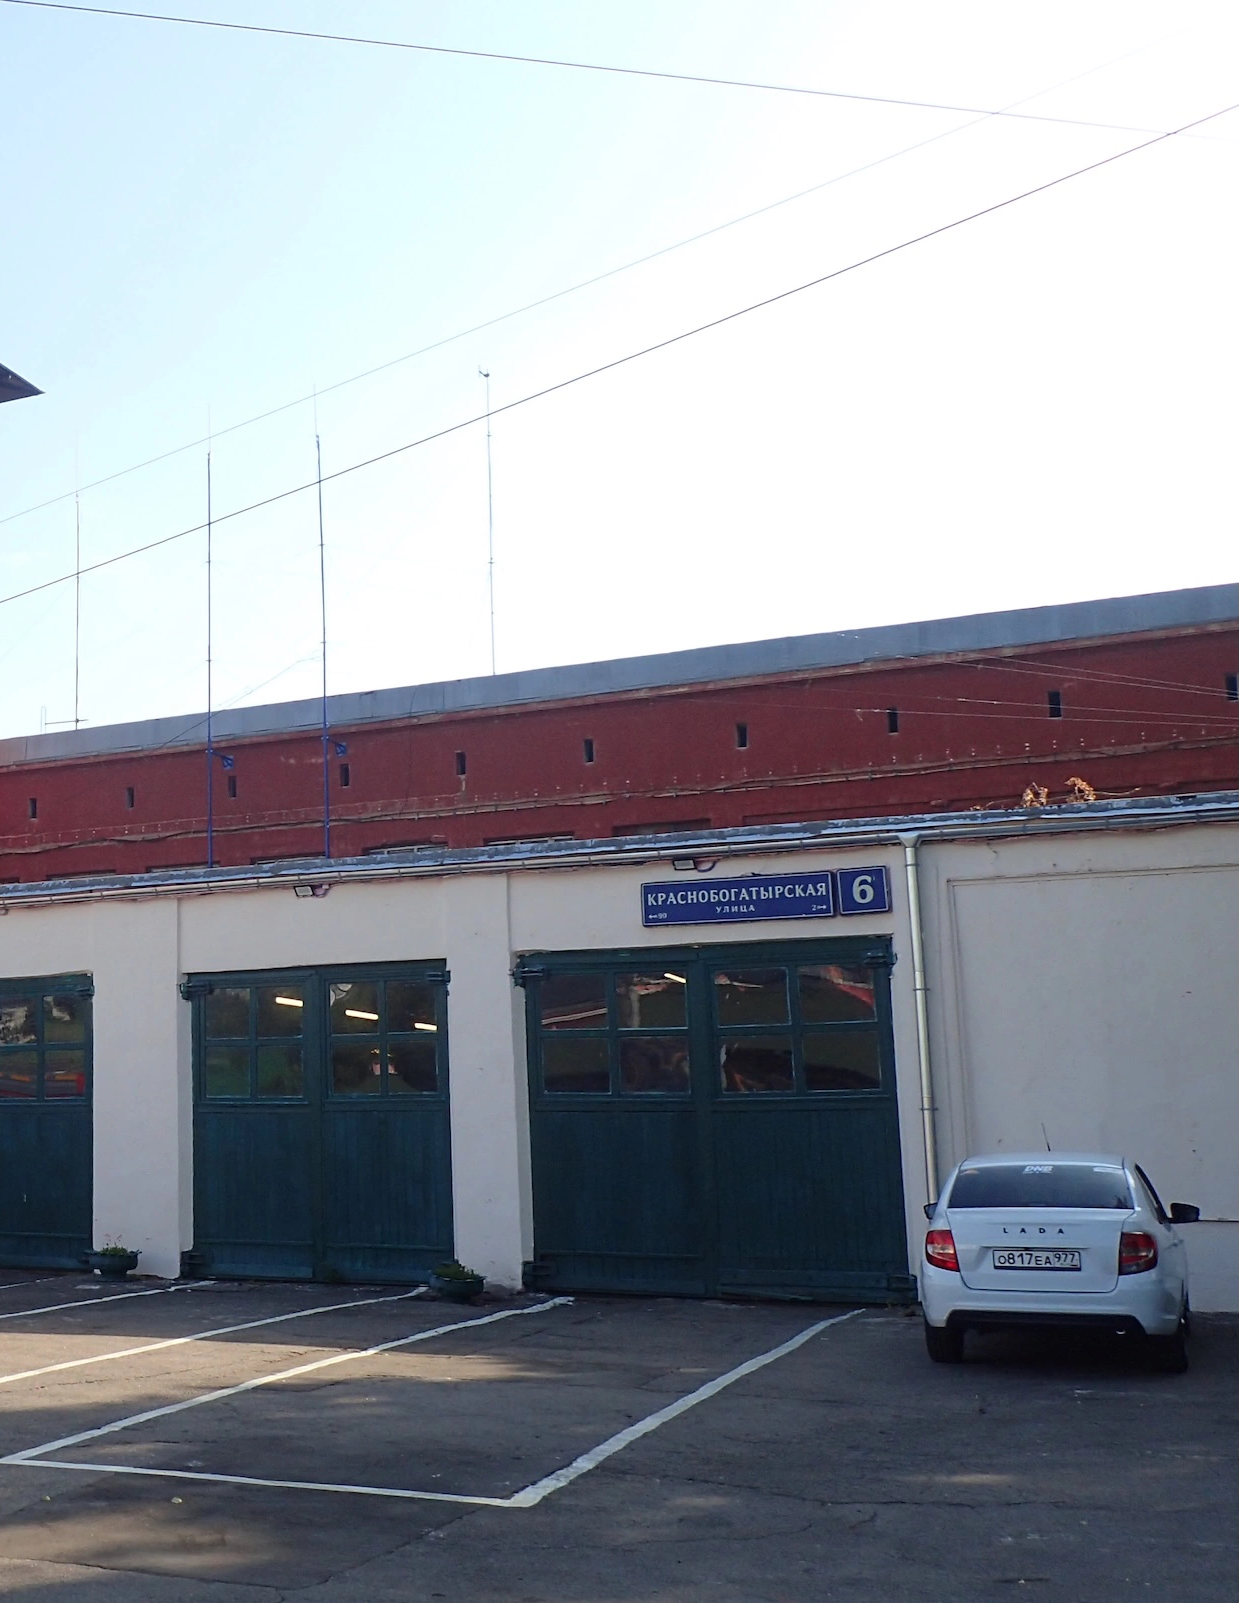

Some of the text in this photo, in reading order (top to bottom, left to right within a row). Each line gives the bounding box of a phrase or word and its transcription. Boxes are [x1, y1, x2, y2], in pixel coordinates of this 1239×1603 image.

[647, 882, 827, 906] КРАСНОБОГАТЫРСКАЯ
[852, 875, 875, 904] 6
[715, 904, 756, 914] УЛИЦА
[1002, 1227, 1065, 1235] LADA
